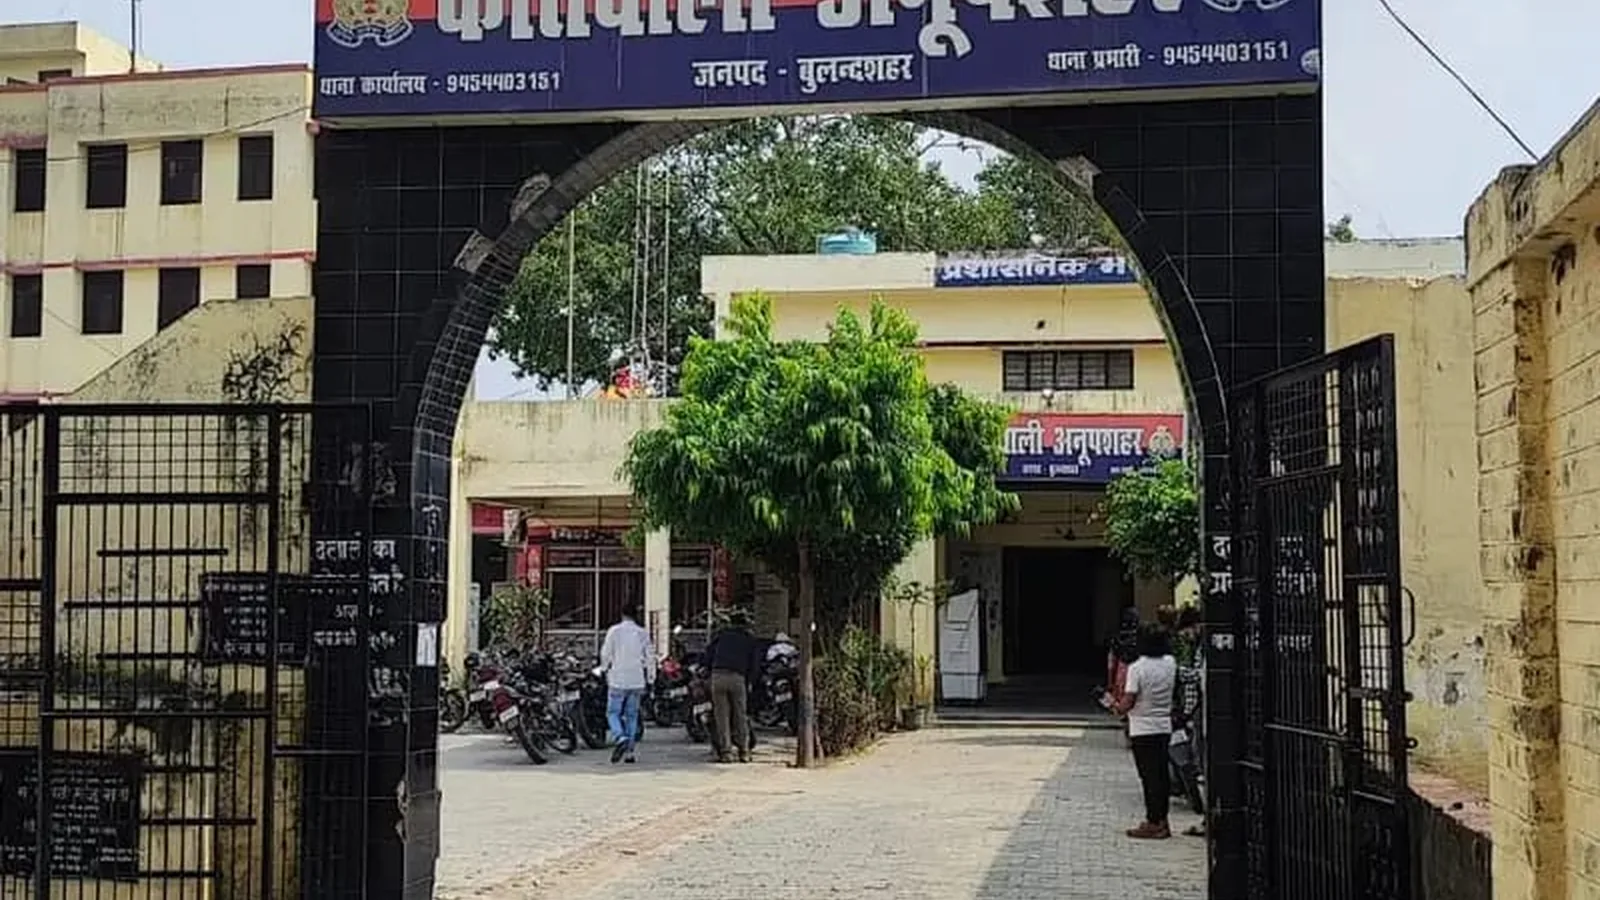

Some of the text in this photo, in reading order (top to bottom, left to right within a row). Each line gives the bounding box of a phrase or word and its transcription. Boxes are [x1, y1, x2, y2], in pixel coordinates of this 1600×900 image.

[1048, 50, 1086, 70] थाना
[1163, 40, 1289, 66] 9454403151
[319, 76, 355, 96] थाना
[360, 71, 427, 95] कार्यालय
[447, 71, 561, 93] 9454403151
[691, 59, 768, 87] जनपद
[796, 54, 914, 94] बुलन्दशहर
[1003, 418, 1144, 467] ाली अनूपशहर
